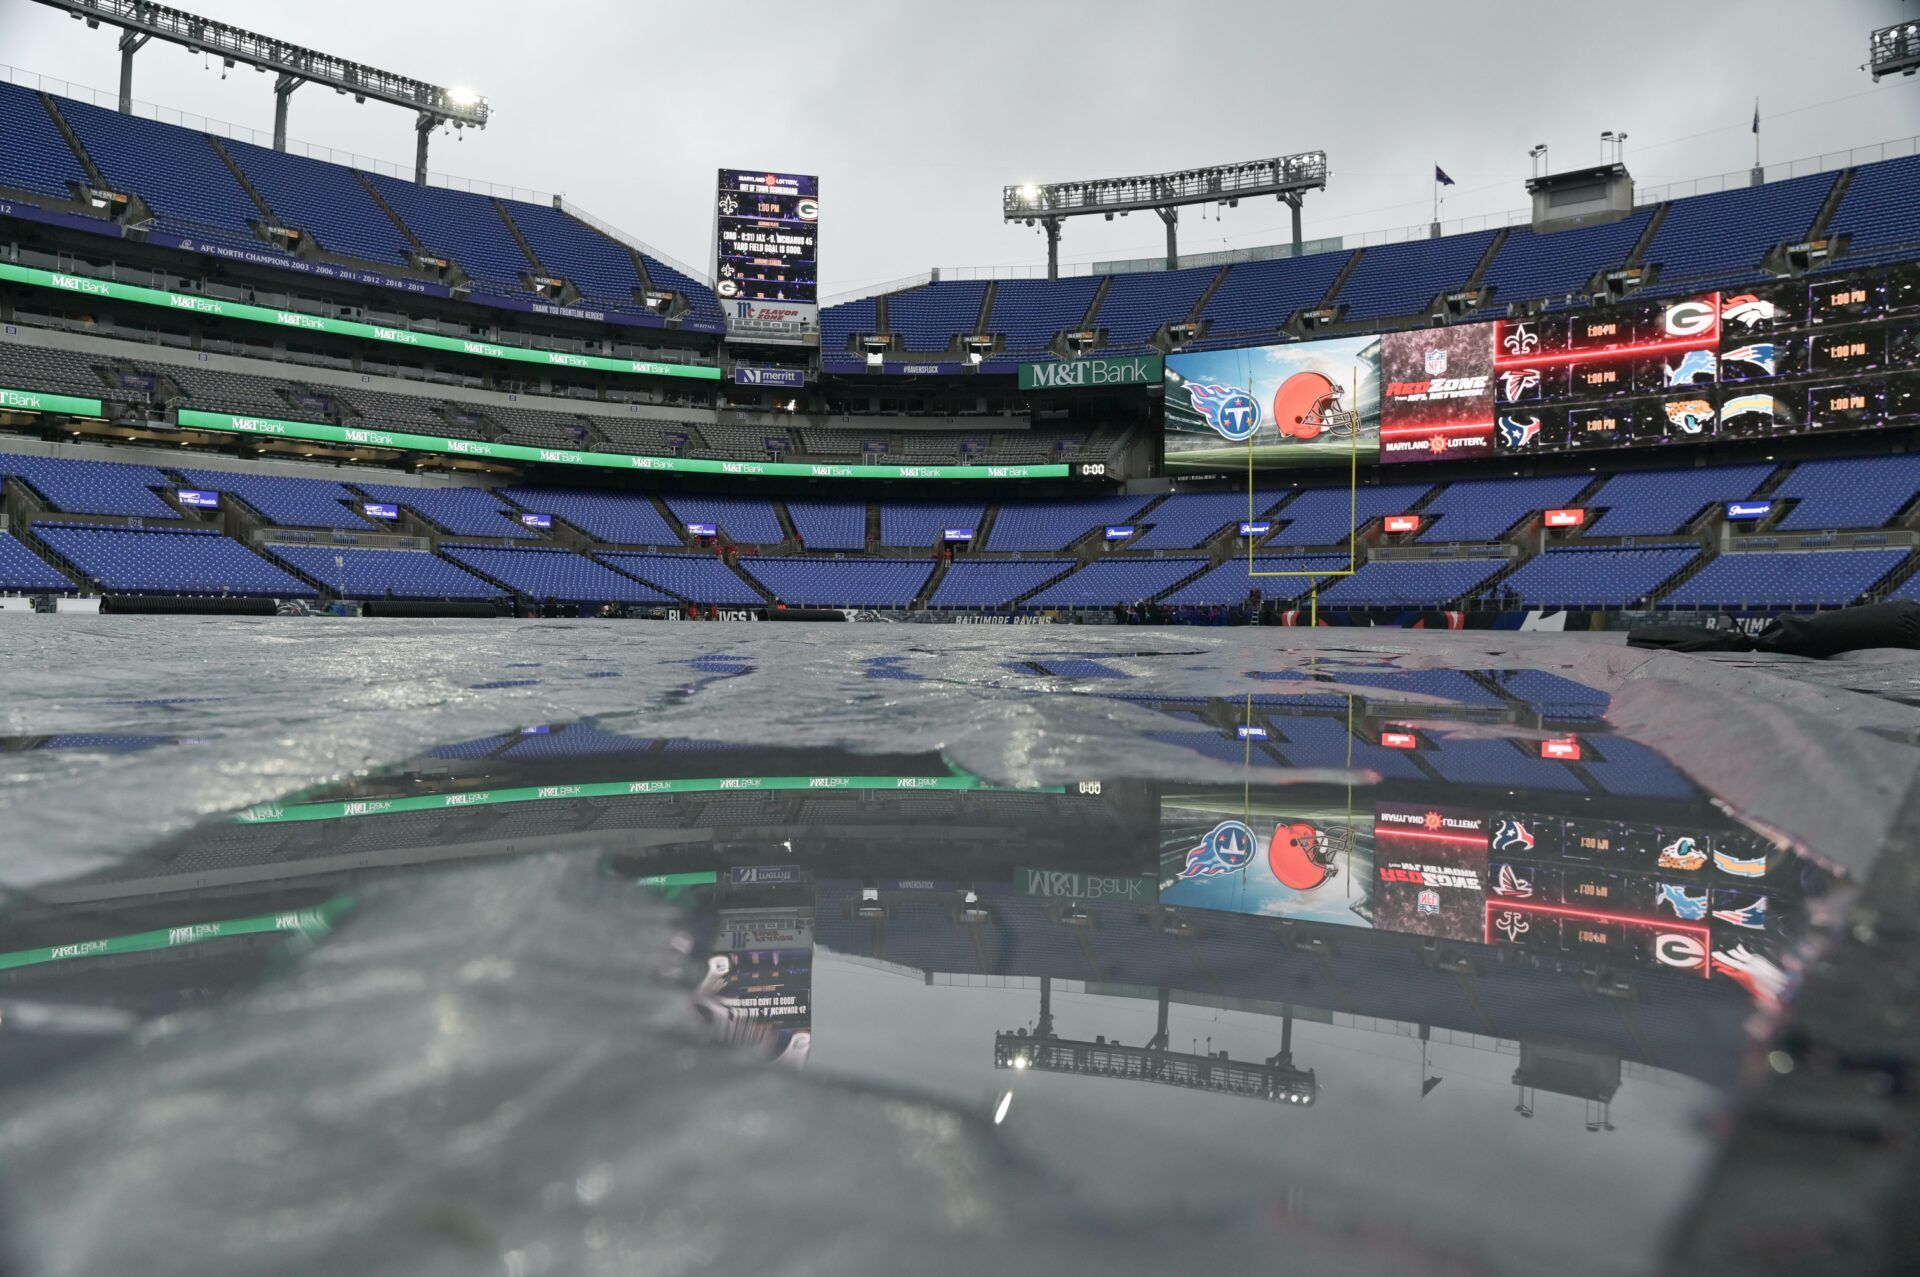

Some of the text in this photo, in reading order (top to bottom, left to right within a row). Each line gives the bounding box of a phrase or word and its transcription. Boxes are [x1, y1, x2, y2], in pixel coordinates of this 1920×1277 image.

[758, 203, 780, 213] 1:00 PM
[756, 233, 766, 243] JAX
[805, 237, 813, 246] 45
[733, 241, 748, 251] YARD
[749, 243, 764, 252] FIELD
[764, 244, 778, 253] GOAL
[779, 245, 785, 254] IS
[200, 244, 425, 292] AFC NORTH CHAMPIONS 2003 2006 2011 2012 2018 2019
[52, 275, 110, 295] M&T Bank
[170, 295, 222, 312] M&T Bank
[1831, 290, 1866, 306] 1:00 PM
[532, 304, 549, 314] THANK
[549, 306, 559, 315] YOU
[560, 308, 584, 319] FRONTLINE
[760, 308, 799, 316] FLAVOR
[278, 313, 325, 329] M&T Bank
[374, 328, 418, 344] M&T Bank
[1588, 324, 1616, 337] 1:00 PM
[464, 342, 504, 357] M&T Bank
[1831, 343, 1865, 358] 1:00 PM
[549, 354, 589, 367] M&T Bank
[632, 362, 671, 374] M&T Bank
[1031, 358, 1149, 387] M&T Bank
[763, 371, 796, 381] merritt
[1587, 372, 1616, 384] 1:00 PM
[9, 392, 41, 408] Bank
[1407, 393, 1428, 402] NFL
[1429, 389, 1485, 400] NETWORK
[1830, 396, 1865, 411] 1:00 PM
[232, 417, 285, 434] M&T Bank
[1587, 419, 1616, 431] 1:00 PM
[345, 429, 393, 445] M&T Bank
[447, 440, 492, 455] M&T Bank
[1386, 440, 1429, 451] MARYLAND
[540, 450, 583, 463] M&T Bank
[632, 457, 674, 469] M&T Bank
[722, 462, 763, 474] M&T Bank
[812, 465, 852, 476] M&T Bank
[900, 467, 940, 477] M&T Bank
[988, 467, 1029, 477] M&T Bank
[1082, 464, 1105, 475] 0:00
